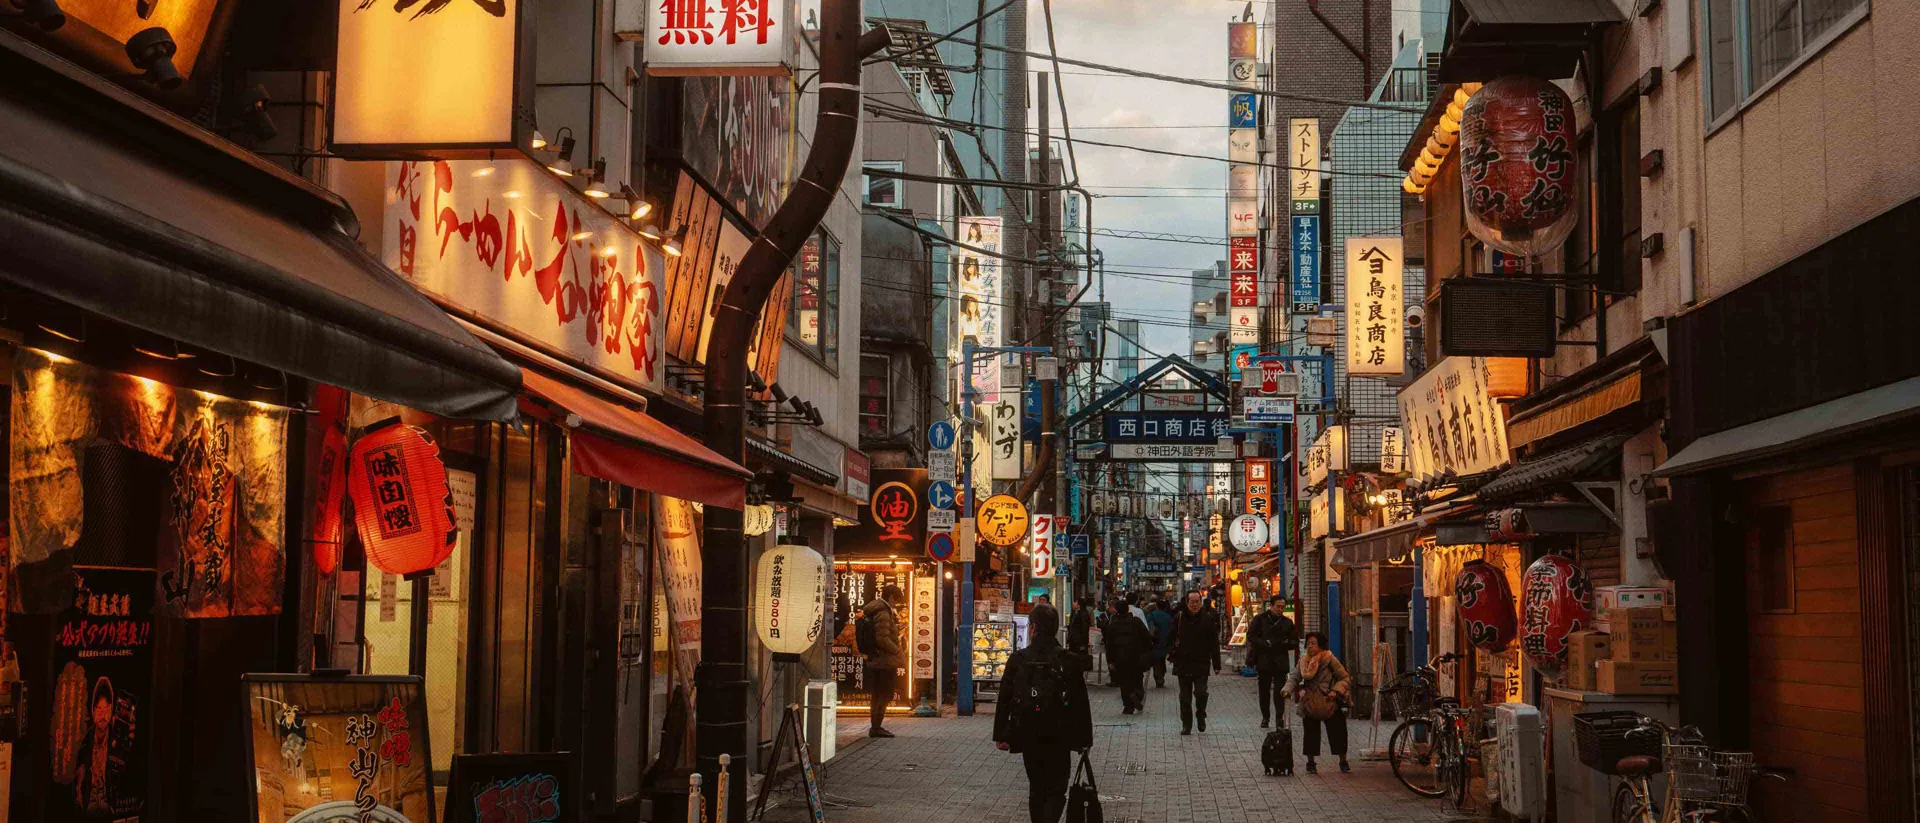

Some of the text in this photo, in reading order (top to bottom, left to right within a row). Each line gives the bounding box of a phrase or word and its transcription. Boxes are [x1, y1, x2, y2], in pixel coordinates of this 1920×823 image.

[1538, 92, 1564, 133] 神田
[1297, 123, 1312, 196] ストレッチ
[1235, 213, 1253, 222] 4F
[1295, 202, 1309, 210] 3F
[1299, 217, 1312, 288] 早水不動産社
[1493, 260, 1524, 268] JCB
[1367, 277, 1387, 366] 鳥良商店
[1154, 395, 1195, 406] 神田駅
[995, 403, 1019, 460] わいず
[1118, 418, 1229, 437] 西口商店街
[1147, 446, 1215, 457] 神田外語学院
[982, 507, 1024, 525] ターリー
[1034, 516, 1050, 576] クスリ
[770, 554, 785, 638] 飲み放題980円
[848, 573, 856, 625] CHAMPION
[857, 573, 865, 606] WORLD
[1524, 561, 1557, 654] 季節料理
[847, 657, 854, 673] 가장
[855, 657, 863, 690] 세상에서
[345, 714, 378, 823] 神山ら
